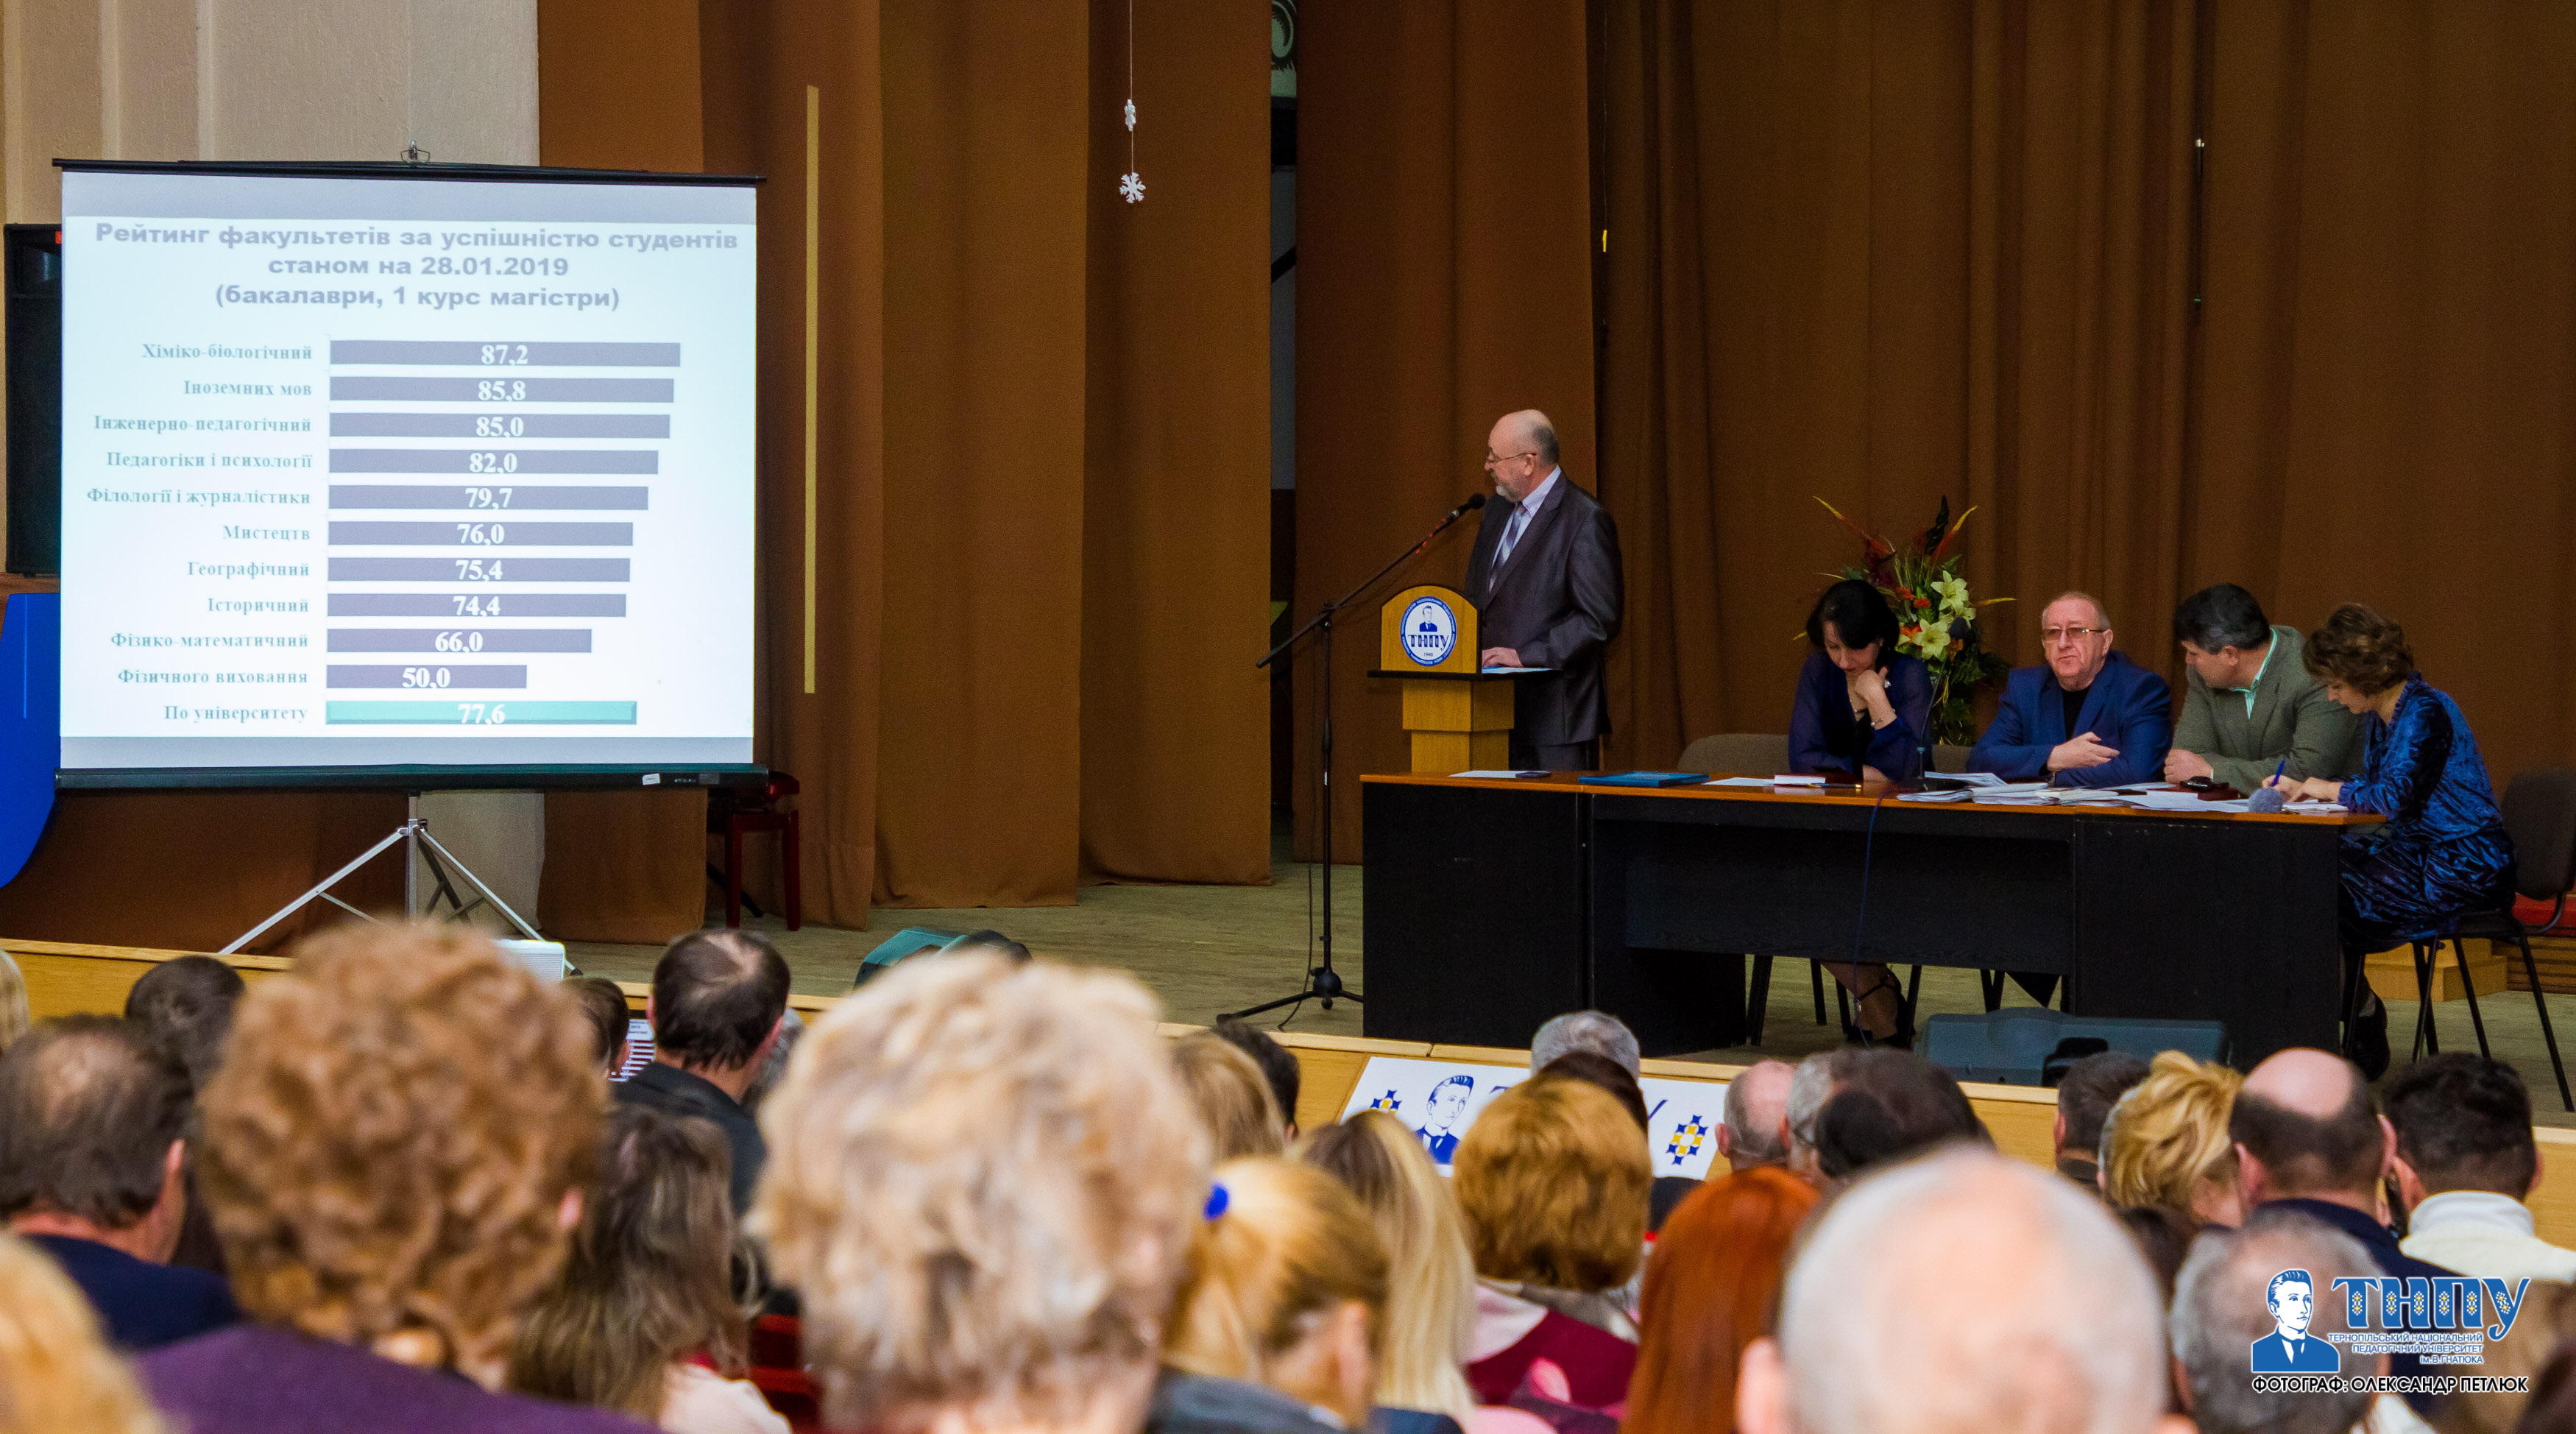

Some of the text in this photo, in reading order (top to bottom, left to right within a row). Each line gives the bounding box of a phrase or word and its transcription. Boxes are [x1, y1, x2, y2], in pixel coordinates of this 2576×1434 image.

[96, 223, 737, 252] Рейтинг факультетів за успішністю студентів
[268, 257, 568, 276] станом на 28.01.2019
[216, 284, 619, 311] (бакалаври, 1 курс магістри)
[142, 343, 313, 360] Хіміко-біологічний
[481, 345, 528, 365] 87,2
[185, 381, 311, 395] Іноземних мов
[478, 381, 526, 401] 85,8
[94, 415, 311, 434] Інженерно-педагогічний
[475, 417, 523, 437] 85,0
[107, 452, 312, 467] Педагогіки і психології
[468, 453, 516, 473] 82,0
[87, 488, 309, 506] Філології і журналістики
[465, 488, 512, 509] 79,7
[224, 526, 309, 540] Мистецтв
[457, 524, 505, 545] 76,0
[188, 562, 308, 579] Географічний
[455, 560, 503, 581] 75,4
[208, 598, 308, 615] Історичний
[453, 596, 500, 616] 74,4
[110, 632, 308, 647] Фізико-математичний
[434, 632, 483, 651] 66,0
[1408, 635, 1449, 651] ТНПУ
[118, 669, 308, 684] Фізичного виховання
[402, 668, 450, 688] 50,0
[165, 706, 307, 724] По університету
[458, 704, 505, 724] 77,6
